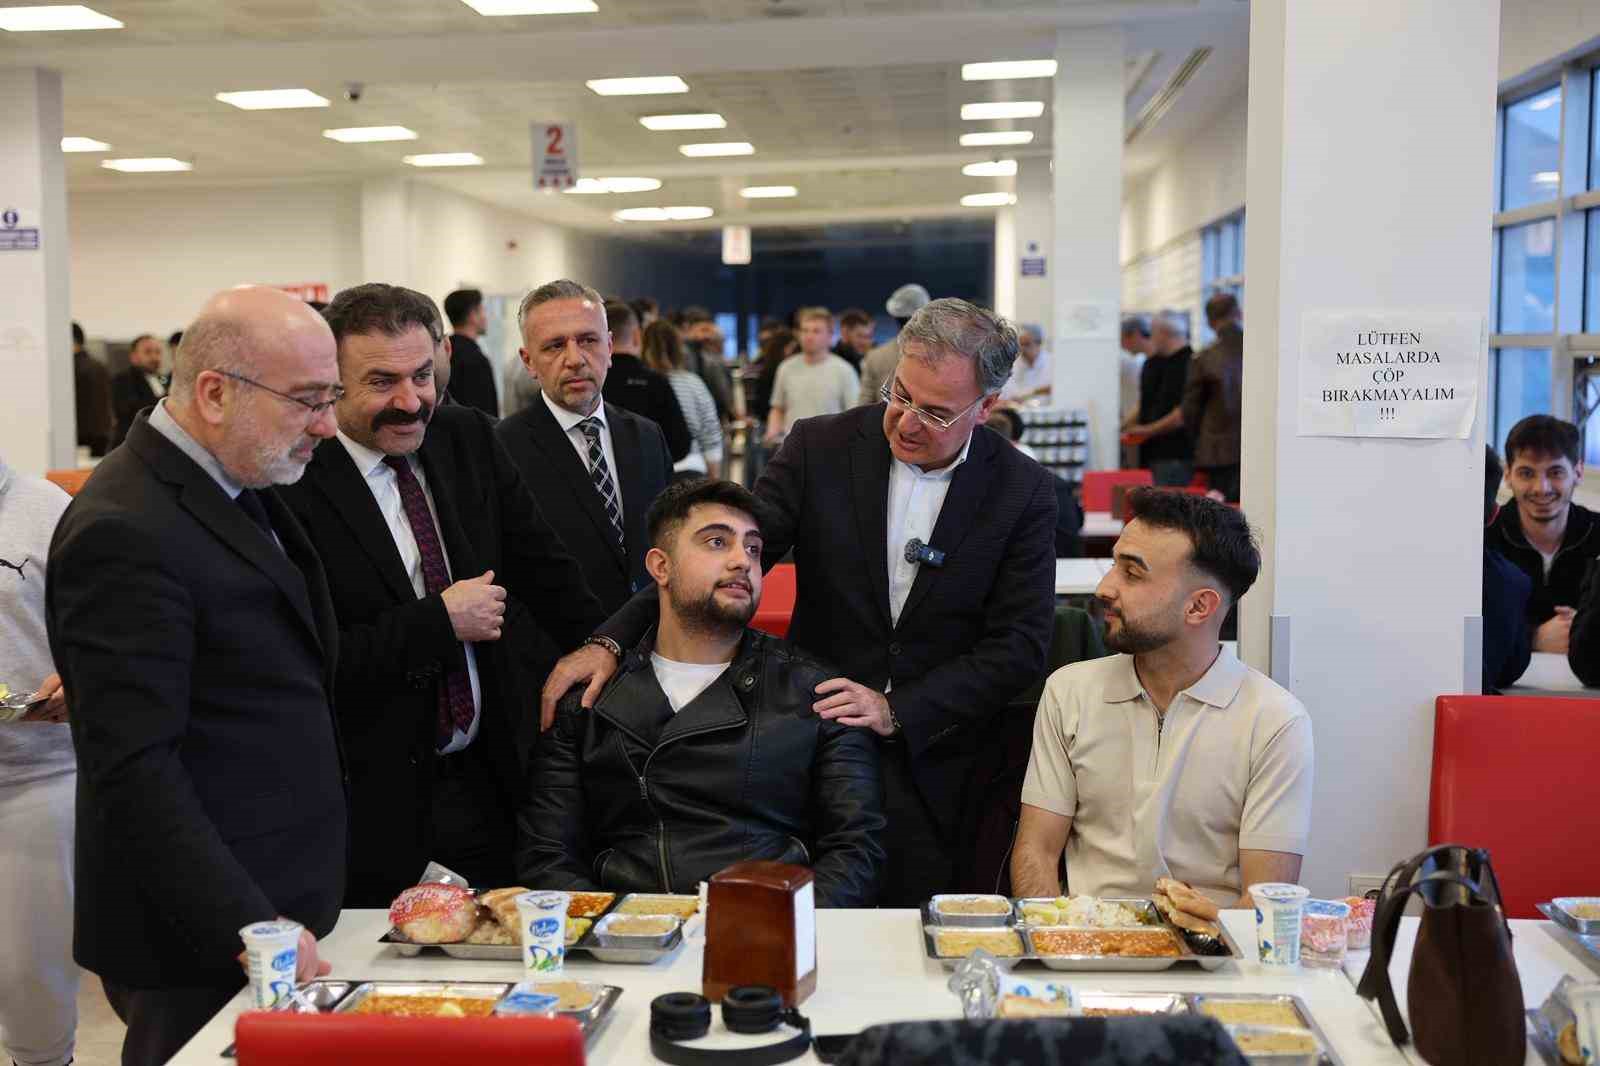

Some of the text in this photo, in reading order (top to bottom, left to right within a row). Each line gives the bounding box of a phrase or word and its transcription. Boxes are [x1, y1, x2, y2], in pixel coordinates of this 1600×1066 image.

[546, 126, 563, 155] 2
[1357, 331, 1421, 345] LÜTFEN
[1336, 351, 1441, 364] MASALARDA
[1372, 368, 1404, 384] ÇÖP
[1322, 388, 1454, 402] BIRAKMAYALIM
[1380, 407, 1395, 419] !!!
